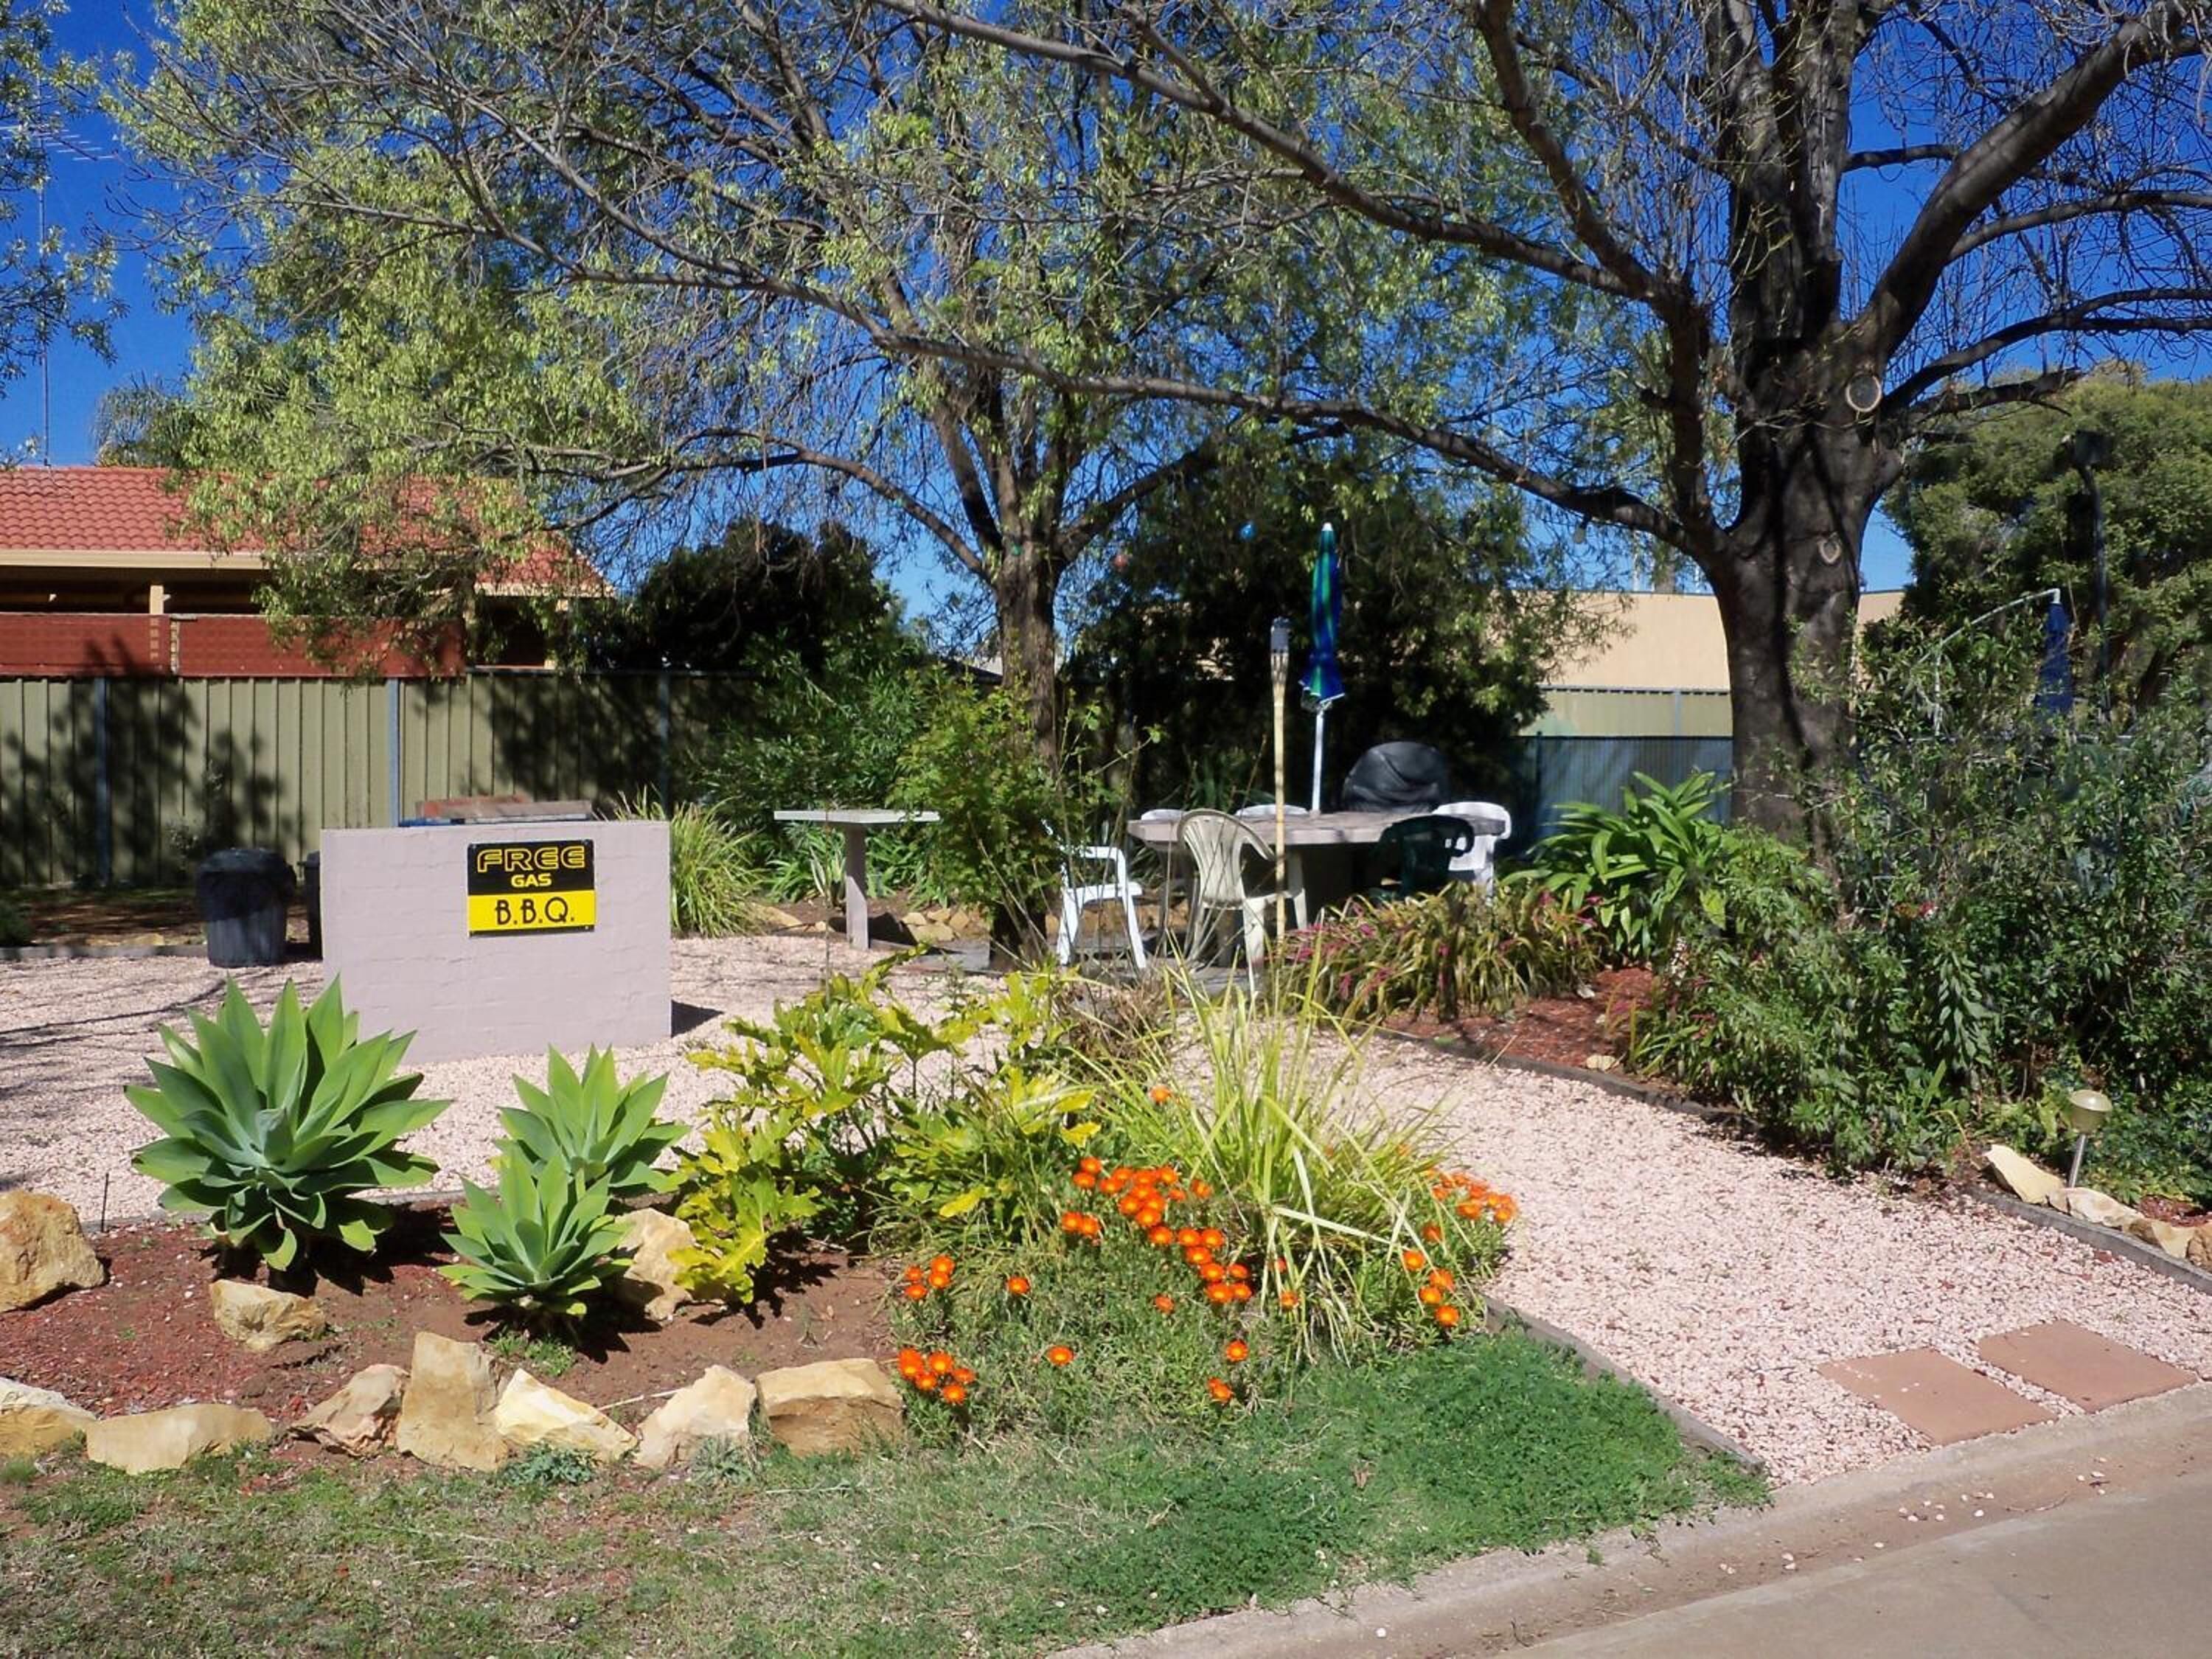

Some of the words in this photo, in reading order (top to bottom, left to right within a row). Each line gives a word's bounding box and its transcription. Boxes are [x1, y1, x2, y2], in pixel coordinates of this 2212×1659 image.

[477, 846, 585, 873] FREE
[511, 873, 552, 888] GAS
[495, 897, 574, 925] B.B.Q.
